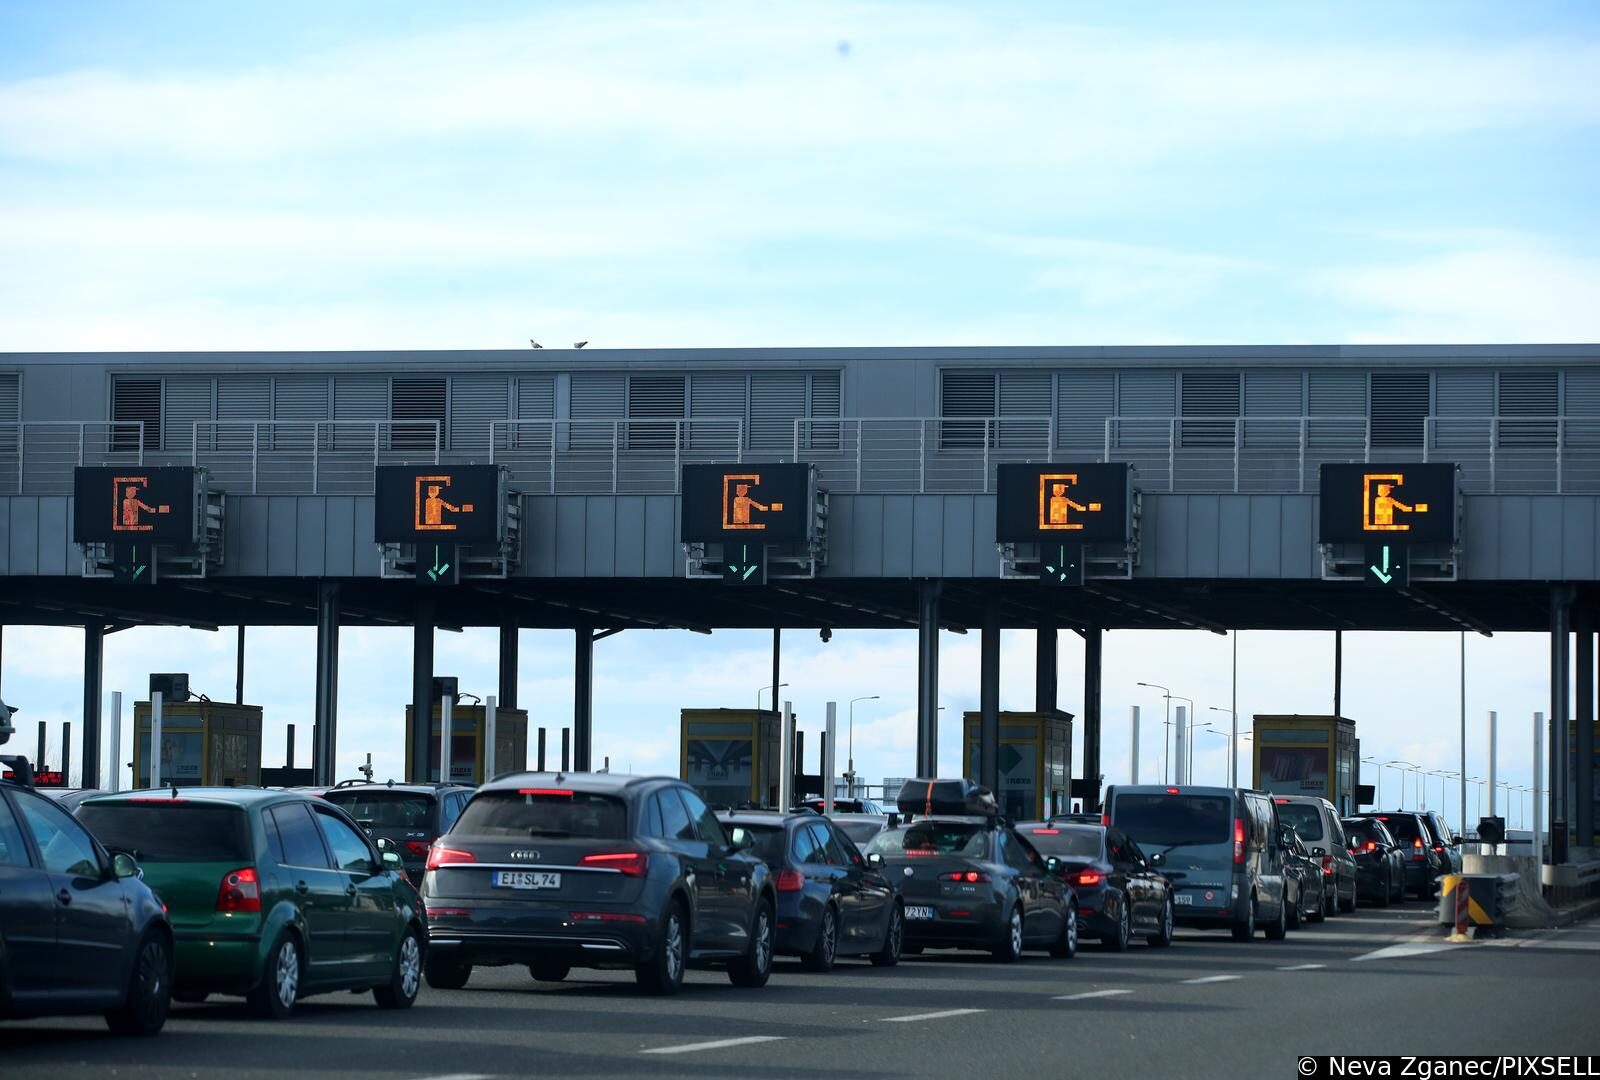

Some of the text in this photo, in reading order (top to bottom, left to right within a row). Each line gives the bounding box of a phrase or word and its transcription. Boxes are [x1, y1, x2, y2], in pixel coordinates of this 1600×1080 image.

[502, 872, 556, 886] EI SL 74
